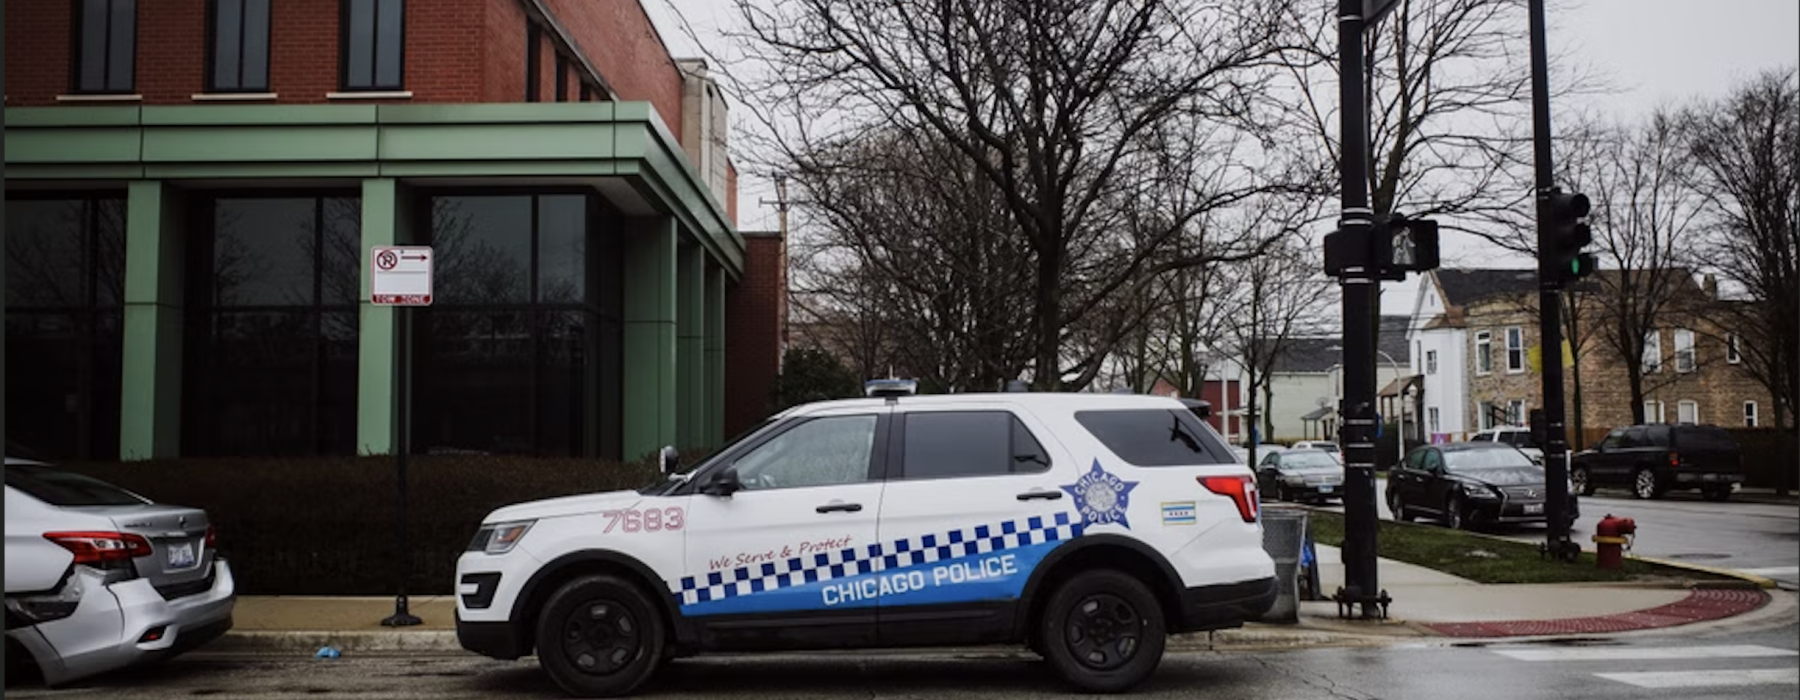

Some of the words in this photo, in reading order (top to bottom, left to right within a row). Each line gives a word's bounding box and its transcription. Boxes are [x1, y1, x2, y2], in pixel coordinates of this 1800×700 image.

[1074, 471, 1124, 495] CHICAGO
[602, 506, 684, 534] 7683
[1082, 503, 1126, 524] POLICE
[709, 555, 731, 570] We
[735, 550, 775, 566] Serve
[780, 545, 791, 558] &
[799, 534, 852, 554] Protect
[822, 570, 925, 605] CHICAGO
[933, 554, 1017, 587] POLICE
